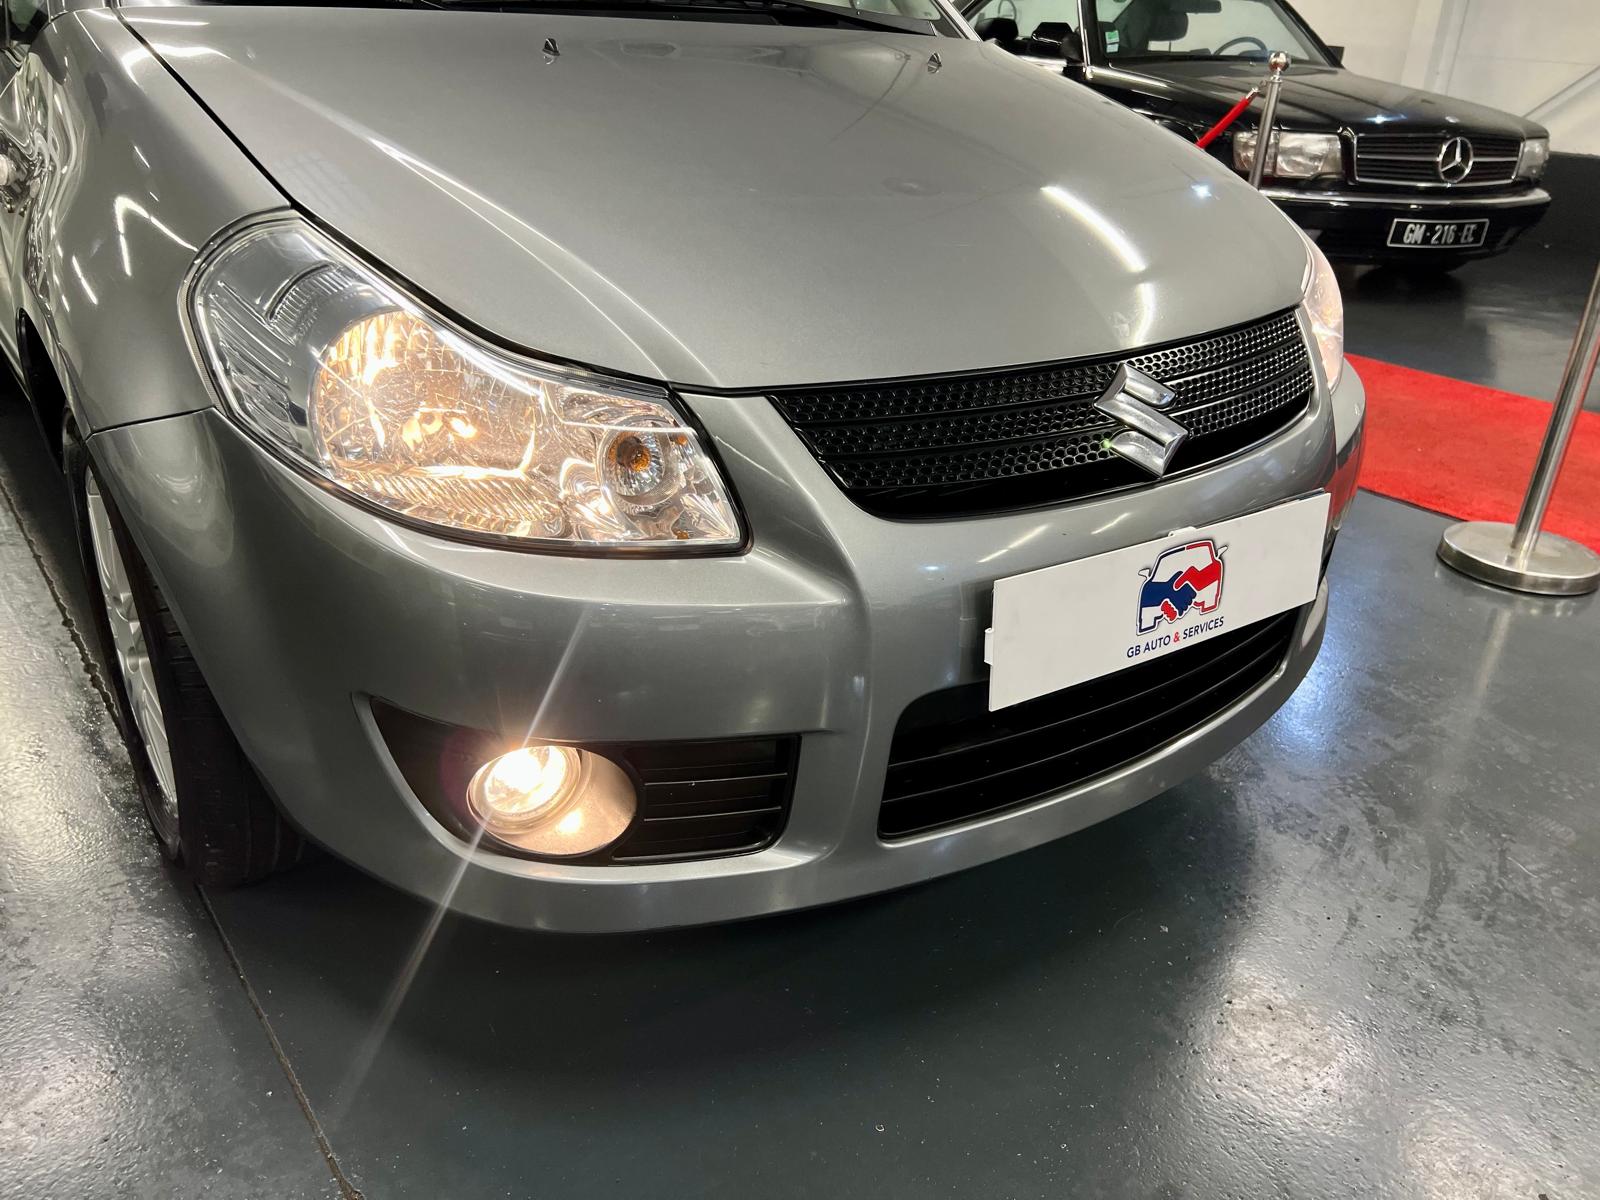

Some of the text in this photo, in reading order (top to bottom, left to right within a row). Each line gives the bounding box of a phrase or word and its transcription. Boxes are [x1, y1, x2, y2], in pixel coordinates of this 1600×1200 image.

[1126, 616, 1225, 658] GB AUTO & SERVICES
